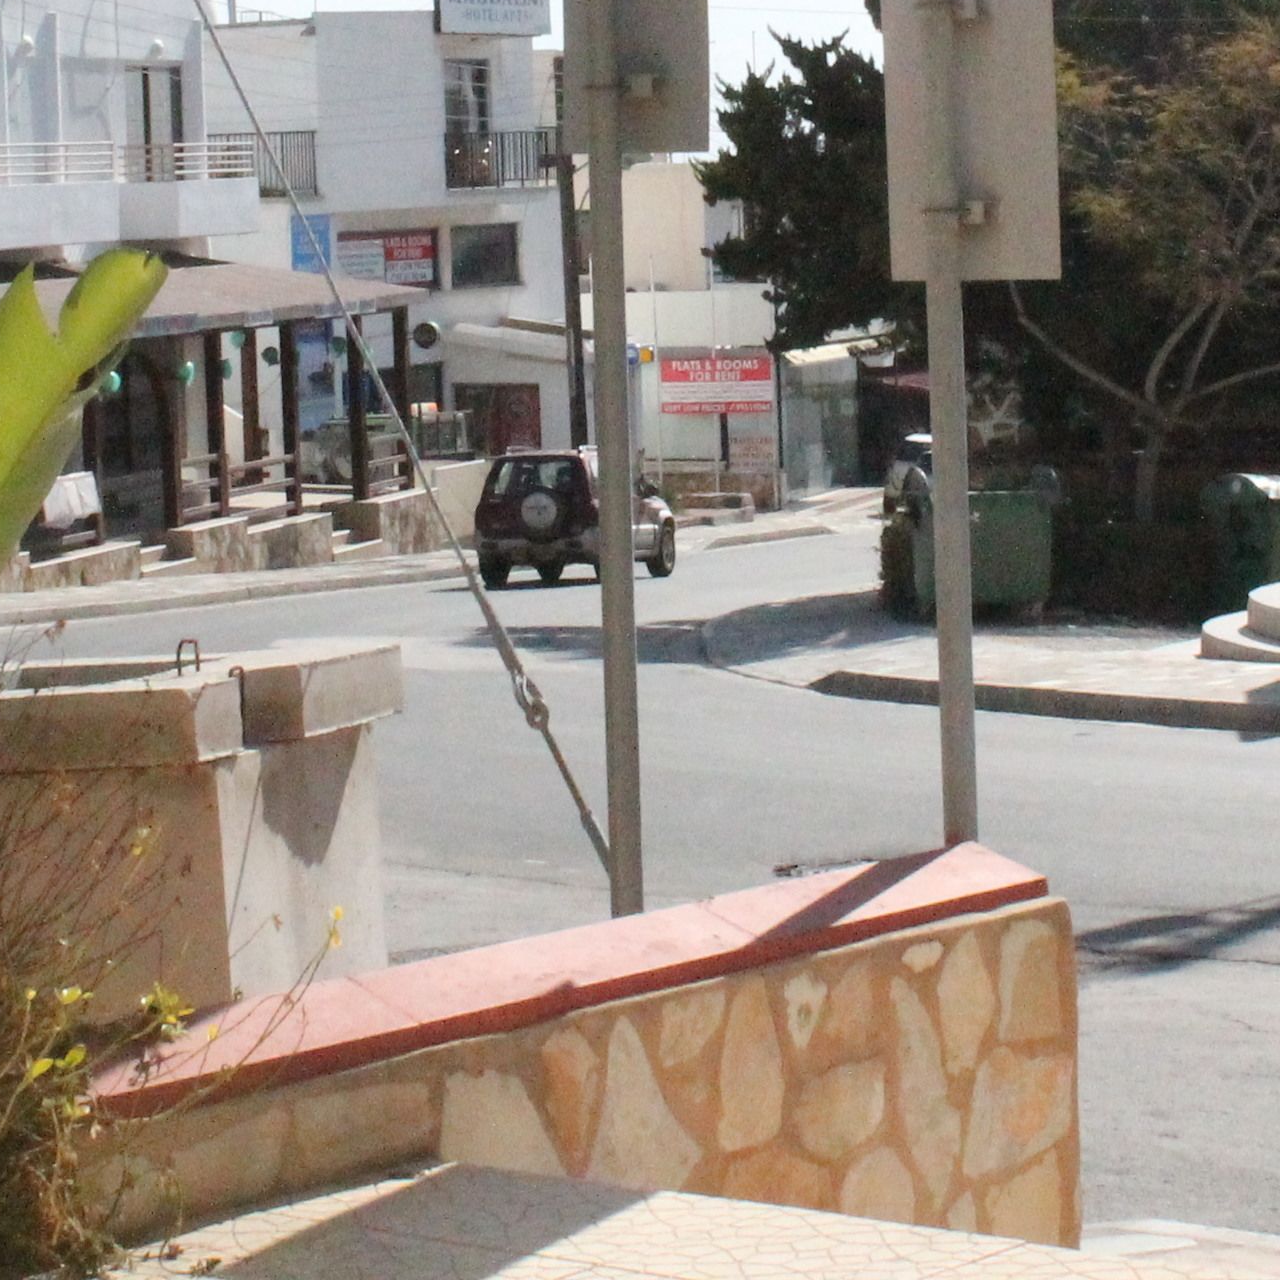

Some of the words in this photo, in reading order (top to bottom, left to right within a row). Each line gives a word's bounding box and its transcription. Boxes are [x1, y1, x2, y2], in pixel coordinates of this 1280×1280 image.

[672, 360, 702, 371] FLATS
[704, 360, 711, 370] &
[716, 360, 759, 370] ROOMS
[688, 371, 711, 381] FOR
[715, 370, 740, 381] RENT
